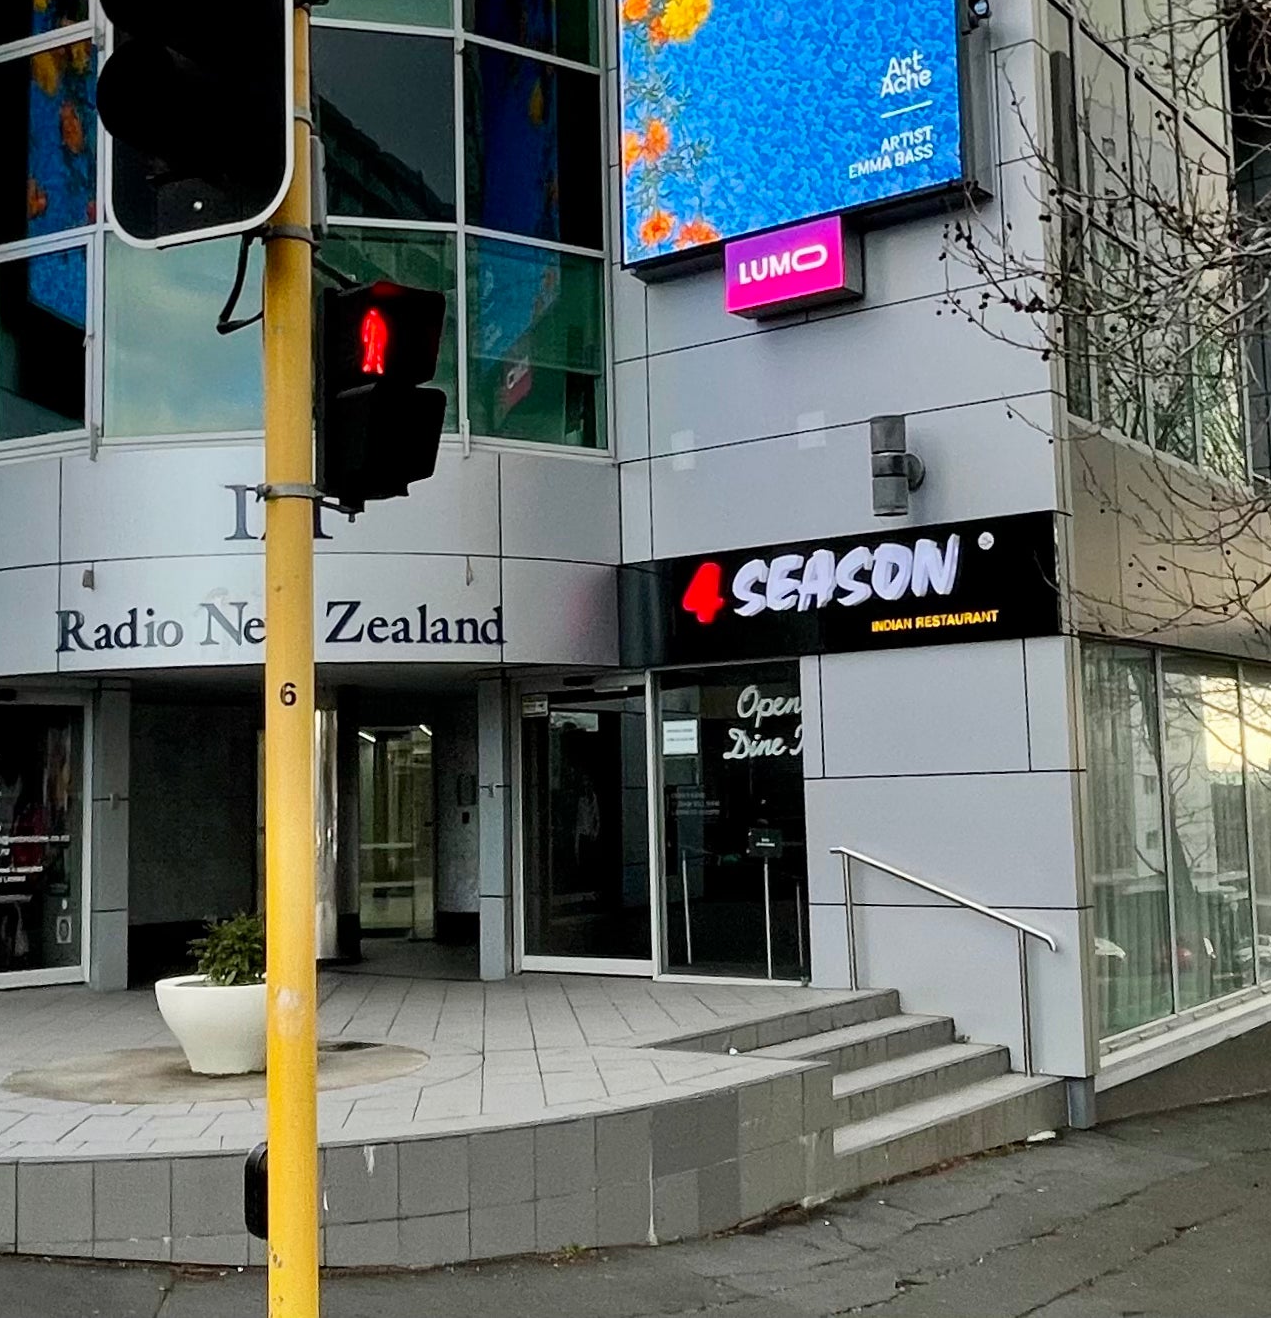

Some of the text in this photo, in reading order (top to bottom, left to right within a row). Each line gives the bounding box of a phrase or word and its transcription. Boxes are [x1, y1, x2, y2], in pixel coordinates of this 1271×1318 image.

[885, 49, 924, 79] Art
[880, 69, 932, 98] Ache
[880, 125, 934, 154] ARTIST
[848, 143, 934, 179] EMMA BASS
[739, 245, 828, 285] LUMO
[681, 533, 960, 624] 4 SEASON
[55, 599, 508, 653] Radio Ne Zealand
[871, 609, 1000, 632] INDIAN RESTAURANT
[280, 682, 297, 706] 6
[737, 685, 802, 728] Open
[723, 728, 787, 759] Dine
